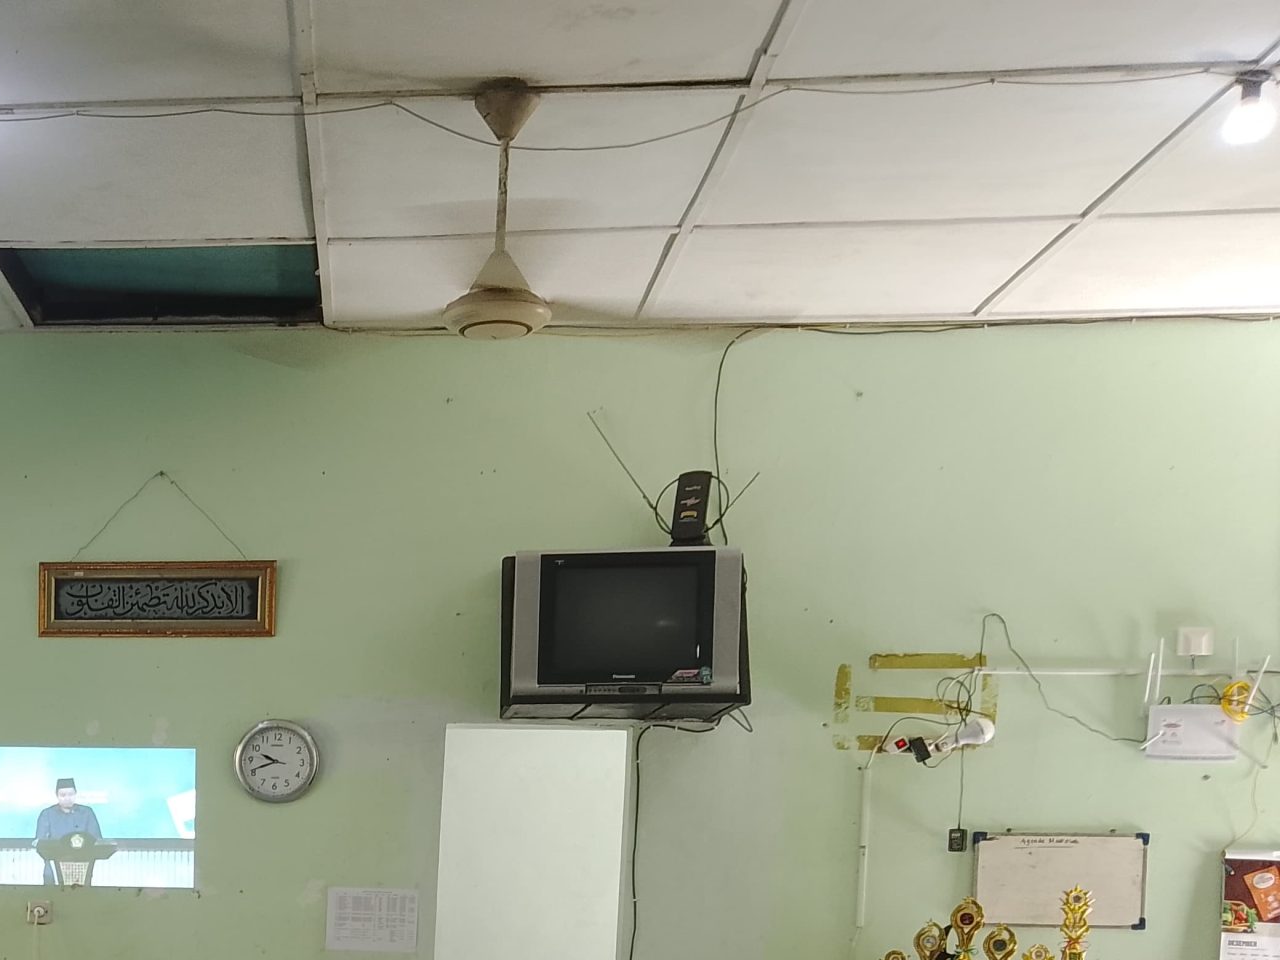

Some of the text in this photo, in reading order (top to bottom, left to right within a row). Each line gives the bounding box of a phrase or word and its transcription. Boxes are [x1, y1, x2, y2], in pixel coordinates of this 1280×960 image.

[261, 736, 269, 744] 11
[274, 733, 282, 741] 12
[252, 744, 260, 752] 10
[296, 746, 302, 754] 2
[248, 756, 253, 764] 9
[299, 759, 305, 767] 3
[272, 782, 277, 790] 6
[284, 779, 290, 787] 5
